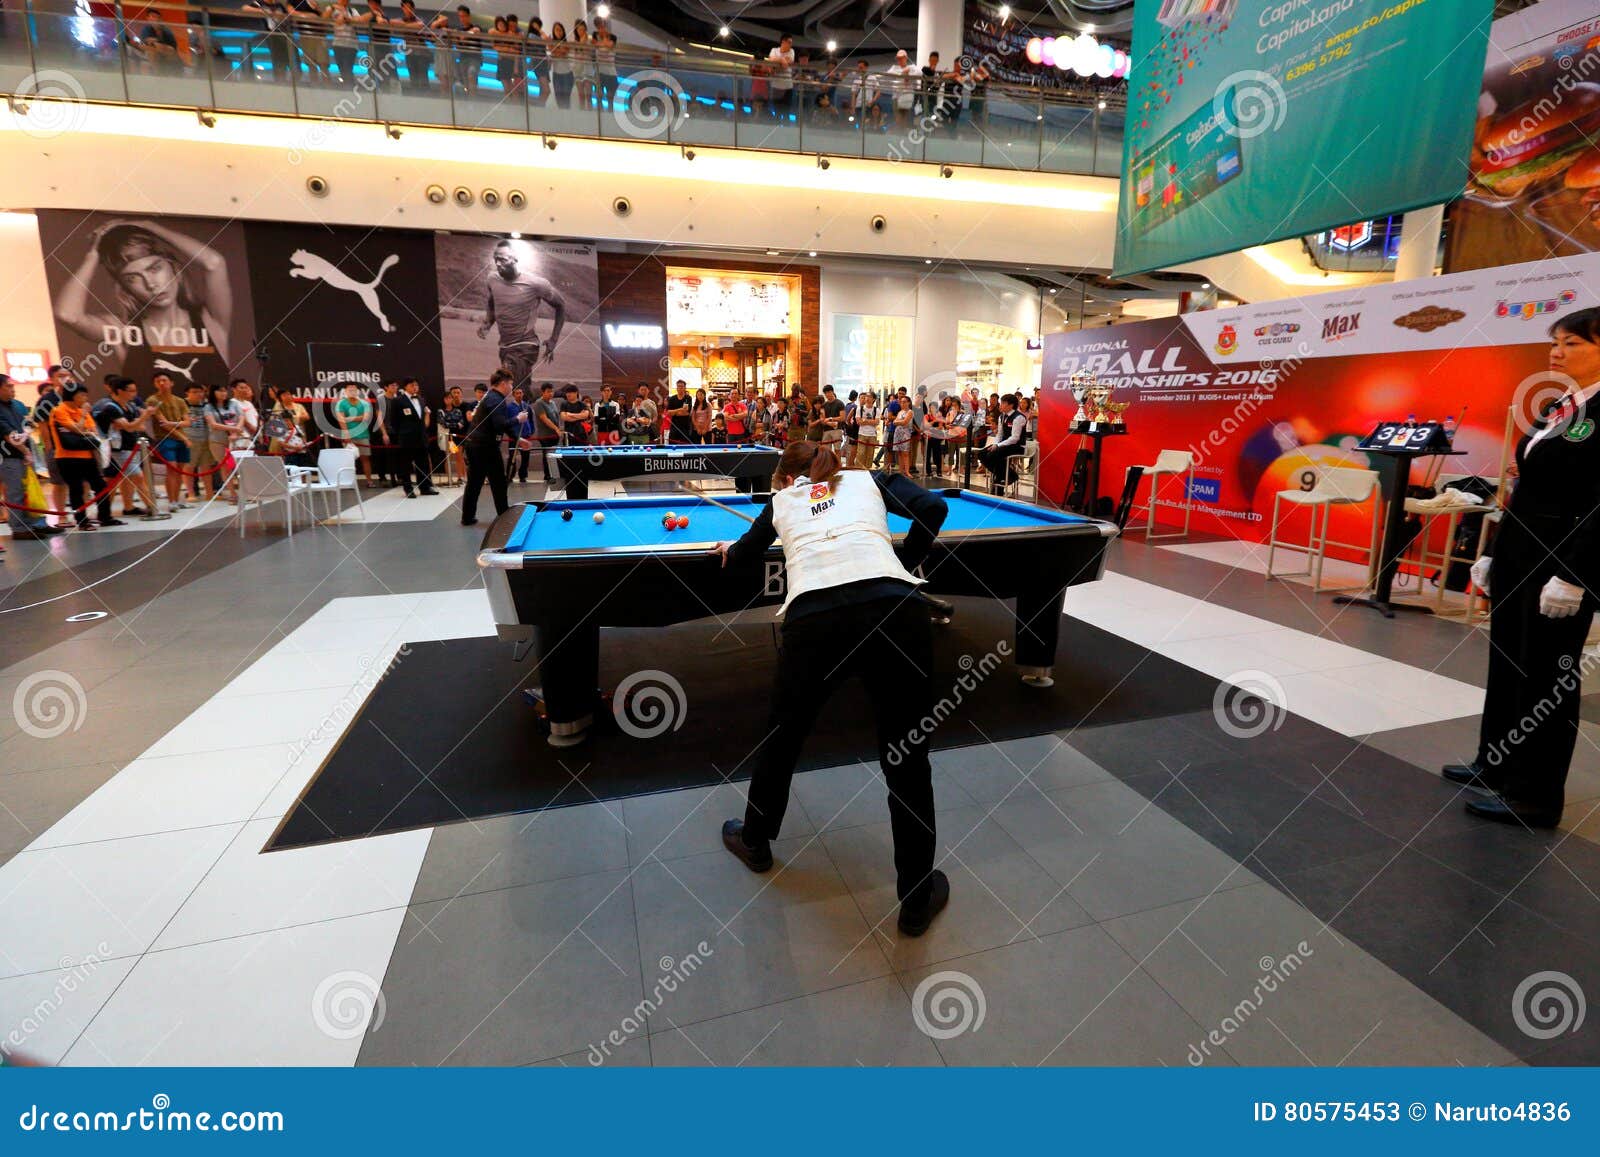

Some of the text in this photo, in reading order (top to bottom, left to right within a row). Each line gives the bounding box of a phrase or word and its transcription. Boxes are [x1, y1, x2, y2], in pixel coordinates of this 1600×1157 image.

[1556, 23, 1592, 44] CHOOSE
[1286, 59, 1316, 81] 6396
[1319, 42, 1353, 67] 5792
[1322, 312, 1361, 339] Max
[102, 324, 208, 348] DO YOU
[1063, 340, 1129, 354] NATIONAL
[316, 371, 381, 382] OPENING
[1053, 369, 1279, 391] CHPIONSHIPS 2016
[292, 387, 370, 399] JANUAY
[1377, 427, 1396, 440] 3
[1411, 428, 1431, 441] 3
[644, 458, 707, 472] BRUNSWICK
[1300, 471, 1316, 492] 9
[811, 498, 836, 516] Max
[1197, 504, 1246, 519] Management
[1247, 511, 1263, 522] LTD
